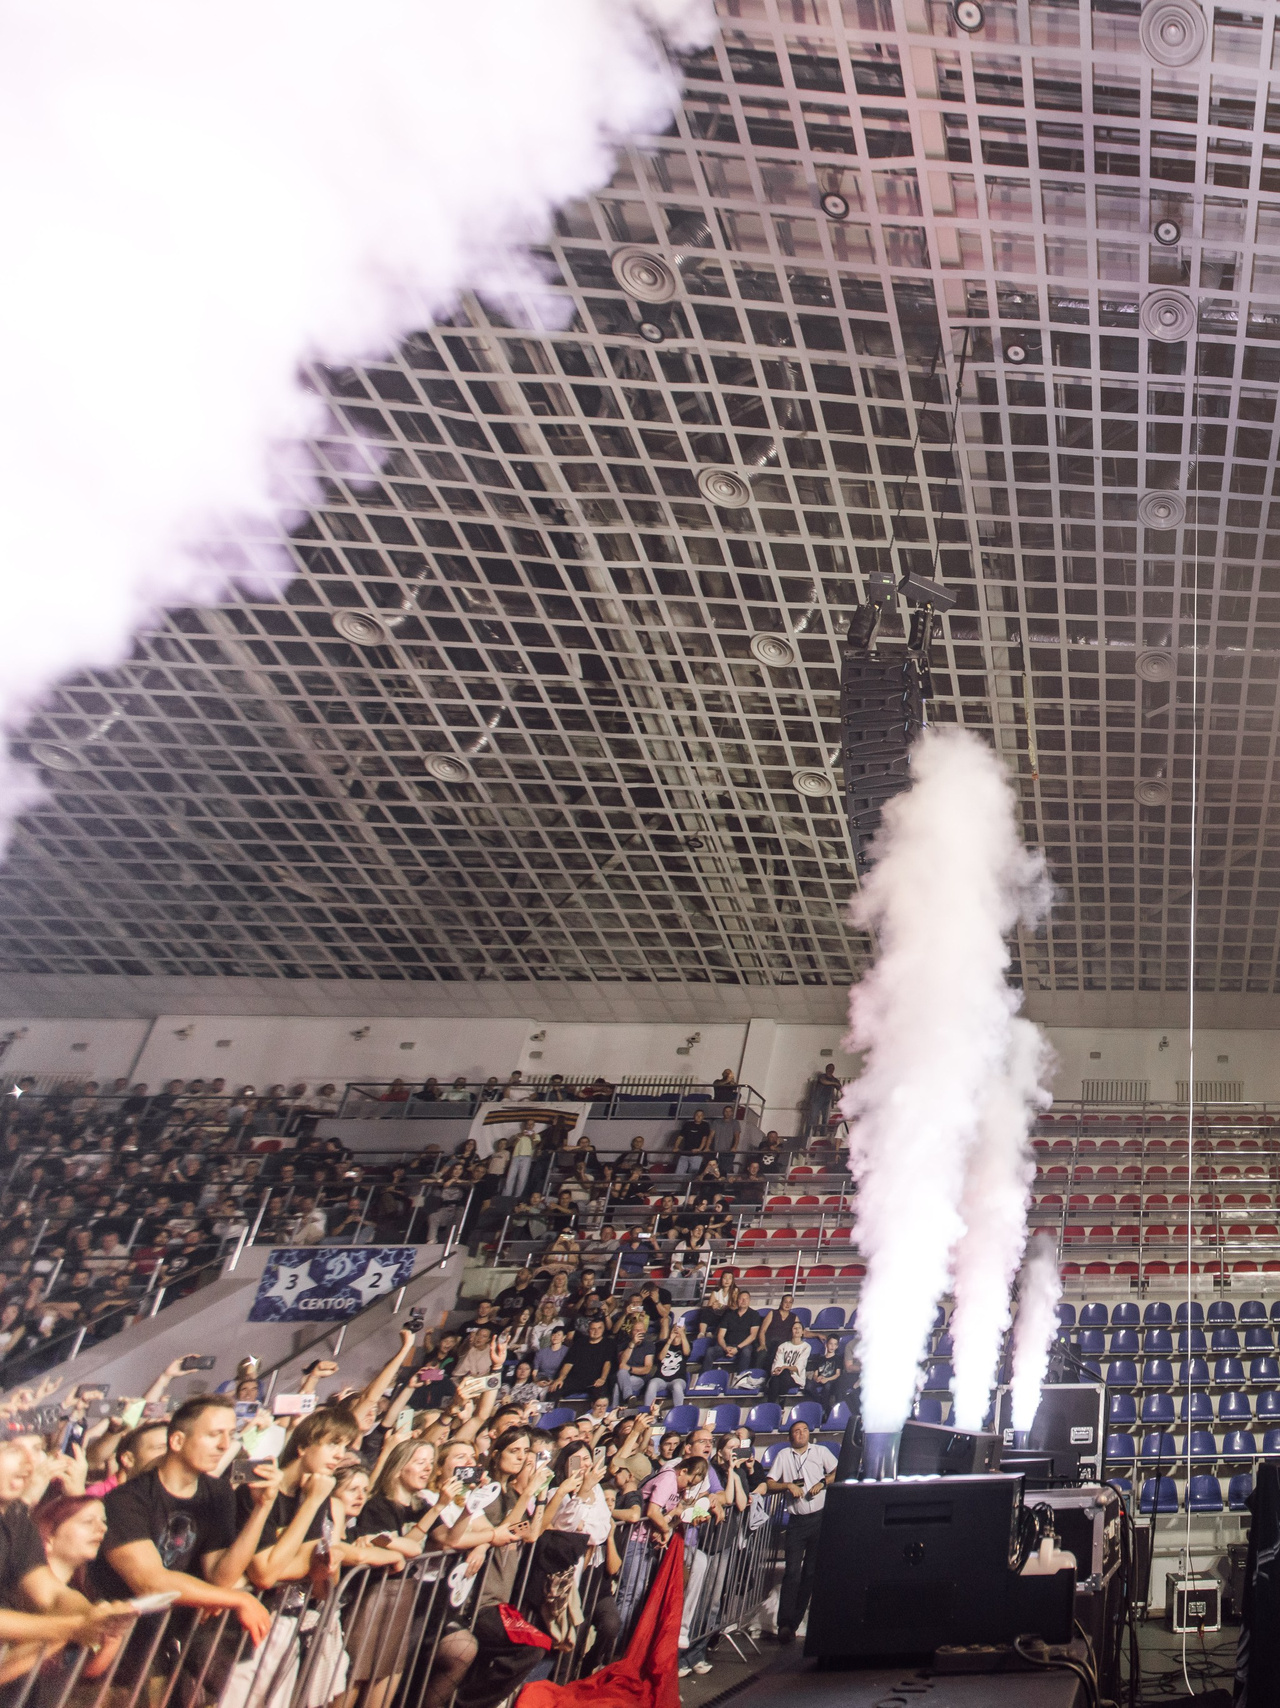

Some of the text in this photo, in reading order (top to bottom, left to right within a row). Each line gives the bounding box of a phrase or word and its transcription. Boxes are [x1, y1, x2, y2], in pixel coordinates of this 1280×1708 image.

[285, 1274, 299, 1290] 3
[368, 1272, 383, 1288] 2
[299, 1298, 356, 1310] СЕКТОР
